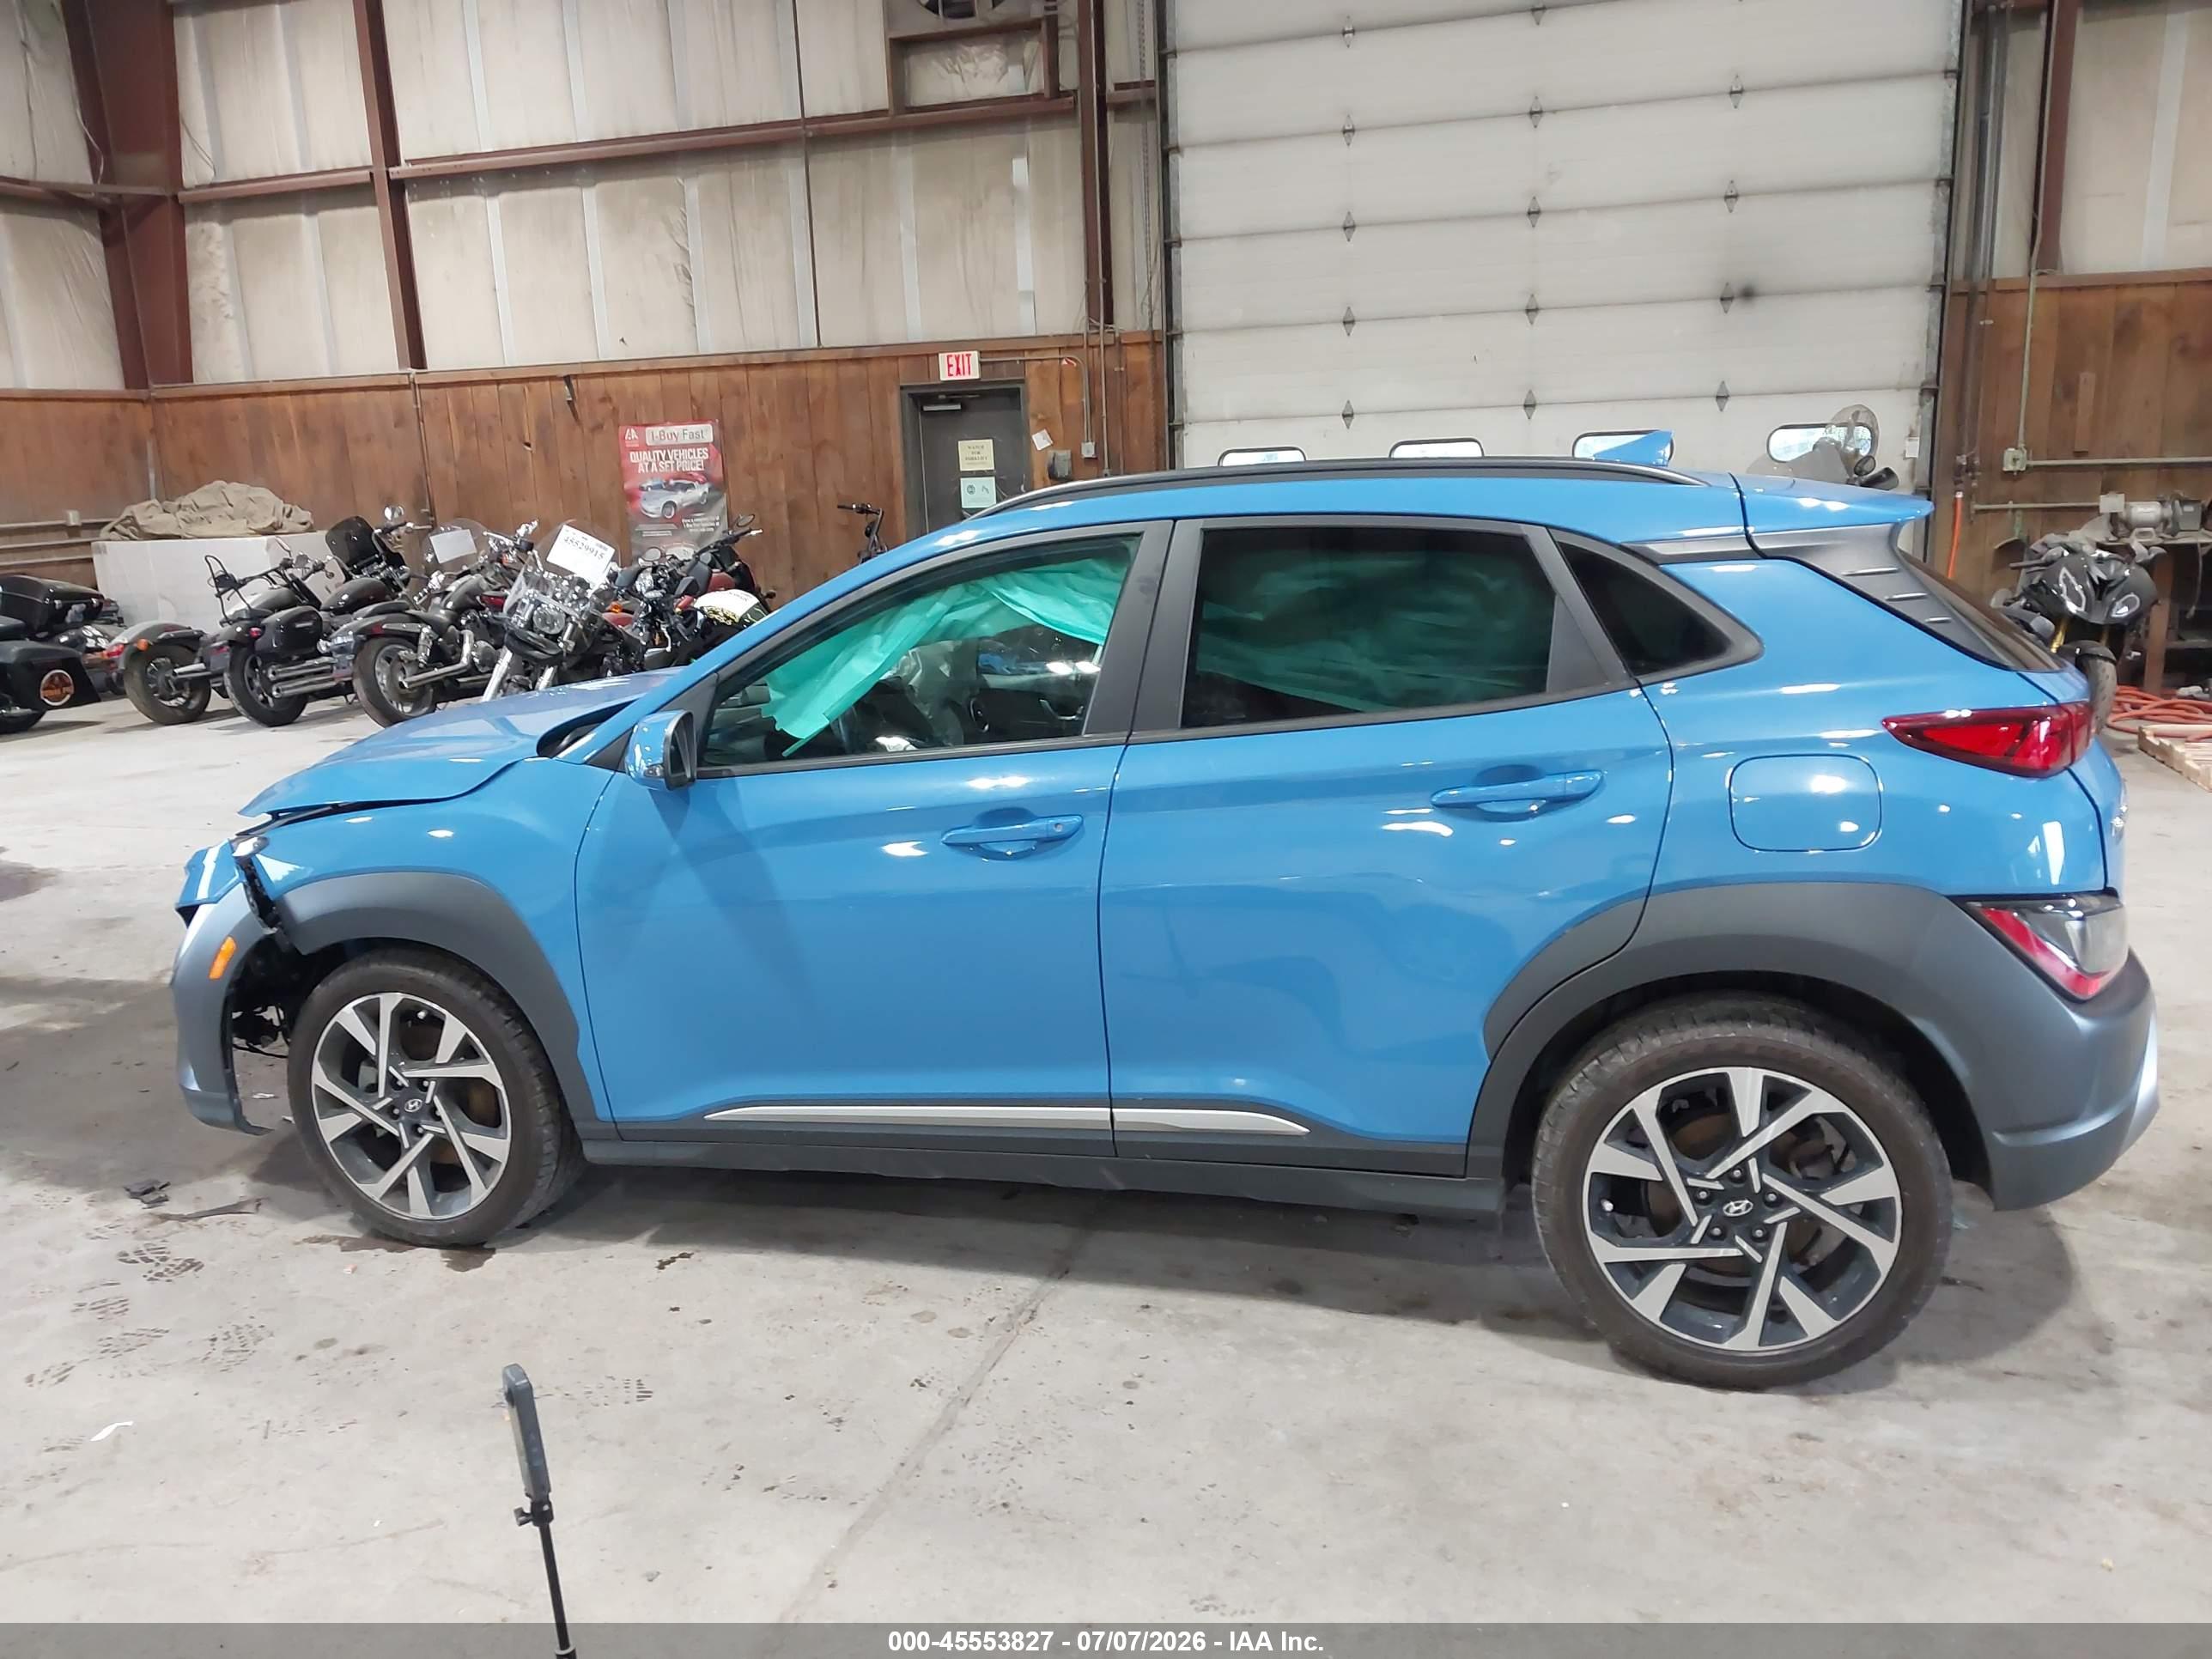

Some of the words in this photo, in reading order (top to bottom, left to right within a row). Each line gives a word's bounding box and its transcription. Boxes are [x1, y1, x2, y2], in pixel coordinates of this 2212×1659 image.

[946, 353, 972, 377] EXIT
[682, 428, 705, 441] Fast
[629, 449, 666, 464] QUALITY
[666, 447, 709, 461] VEHICLES
[638, 462, 653, 473] AT
[651, 462, 658, 472] A
[658, 461, 676, 472] SET
[676, 459, 705, 471] PRICE!
